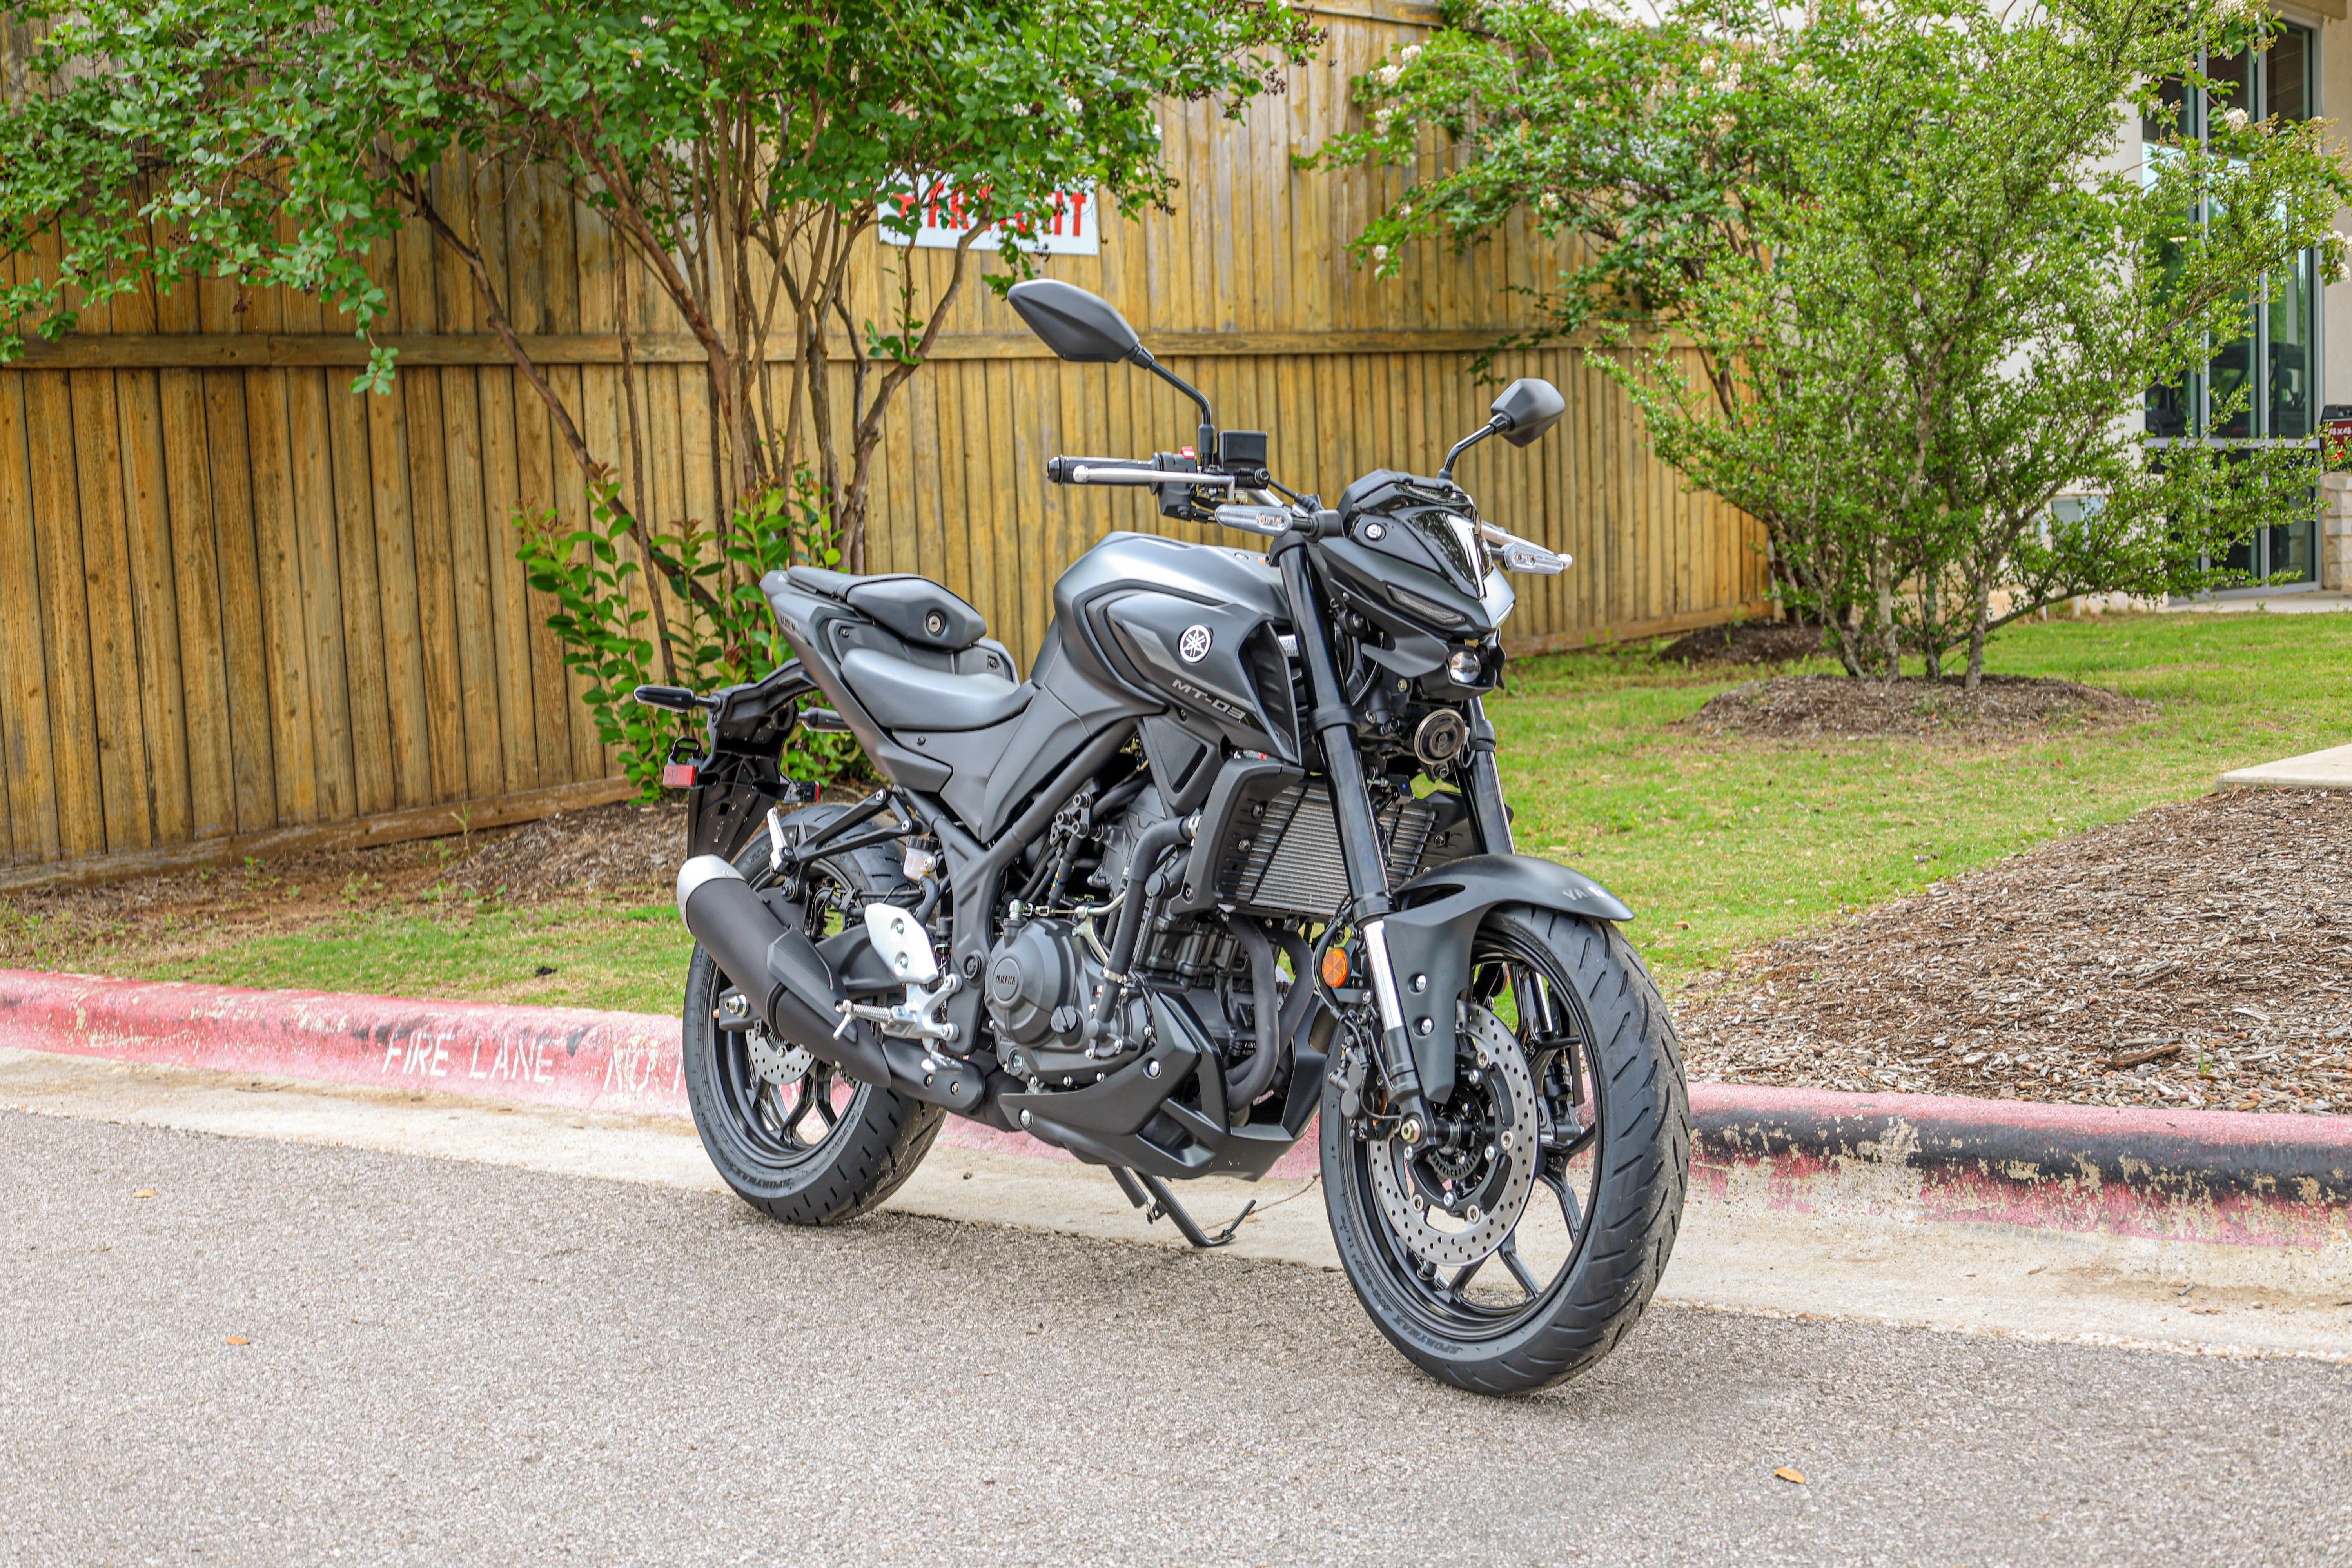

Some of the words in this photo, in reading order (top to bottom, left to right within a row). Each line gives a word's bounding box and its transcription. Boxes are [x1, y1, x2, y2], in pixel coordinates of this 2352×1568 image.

[1172, 679, 1246, 720] MT-03
[995, 974, 1015, 985] YAMAHA
[381, 1032, 456, 1076] FIRE
[469, 1034, 559, 1084] LANE
